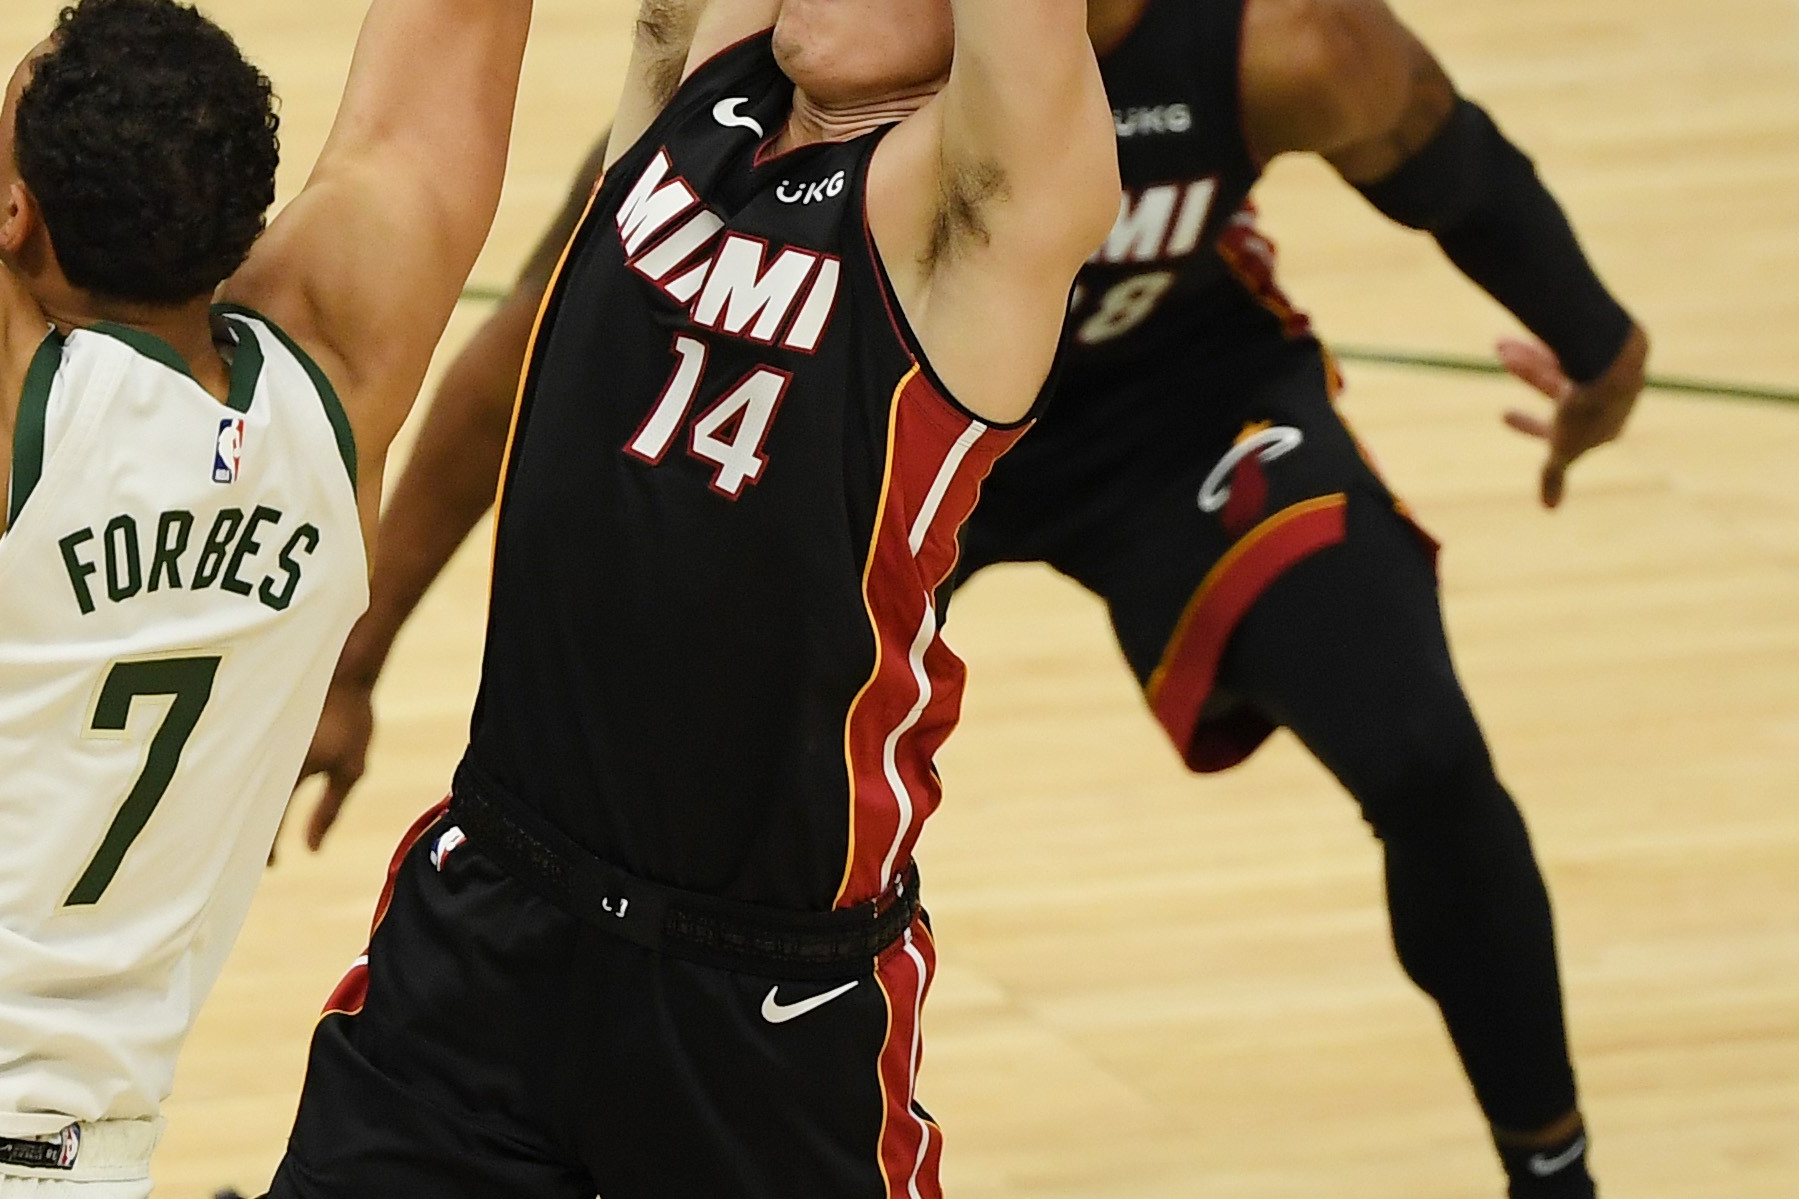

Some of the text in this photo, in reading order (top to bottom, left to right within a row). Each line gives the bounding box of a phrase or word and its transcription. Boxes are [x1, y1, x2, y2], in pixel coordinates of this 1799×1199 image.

[775, 170, 845, 205] UKG
[1068, 270, 1175, 345] 8
[624, 330, 791, 498] 14
[58, 504, 320, 616] FORBES
[61, 653, 225, 909] 7
